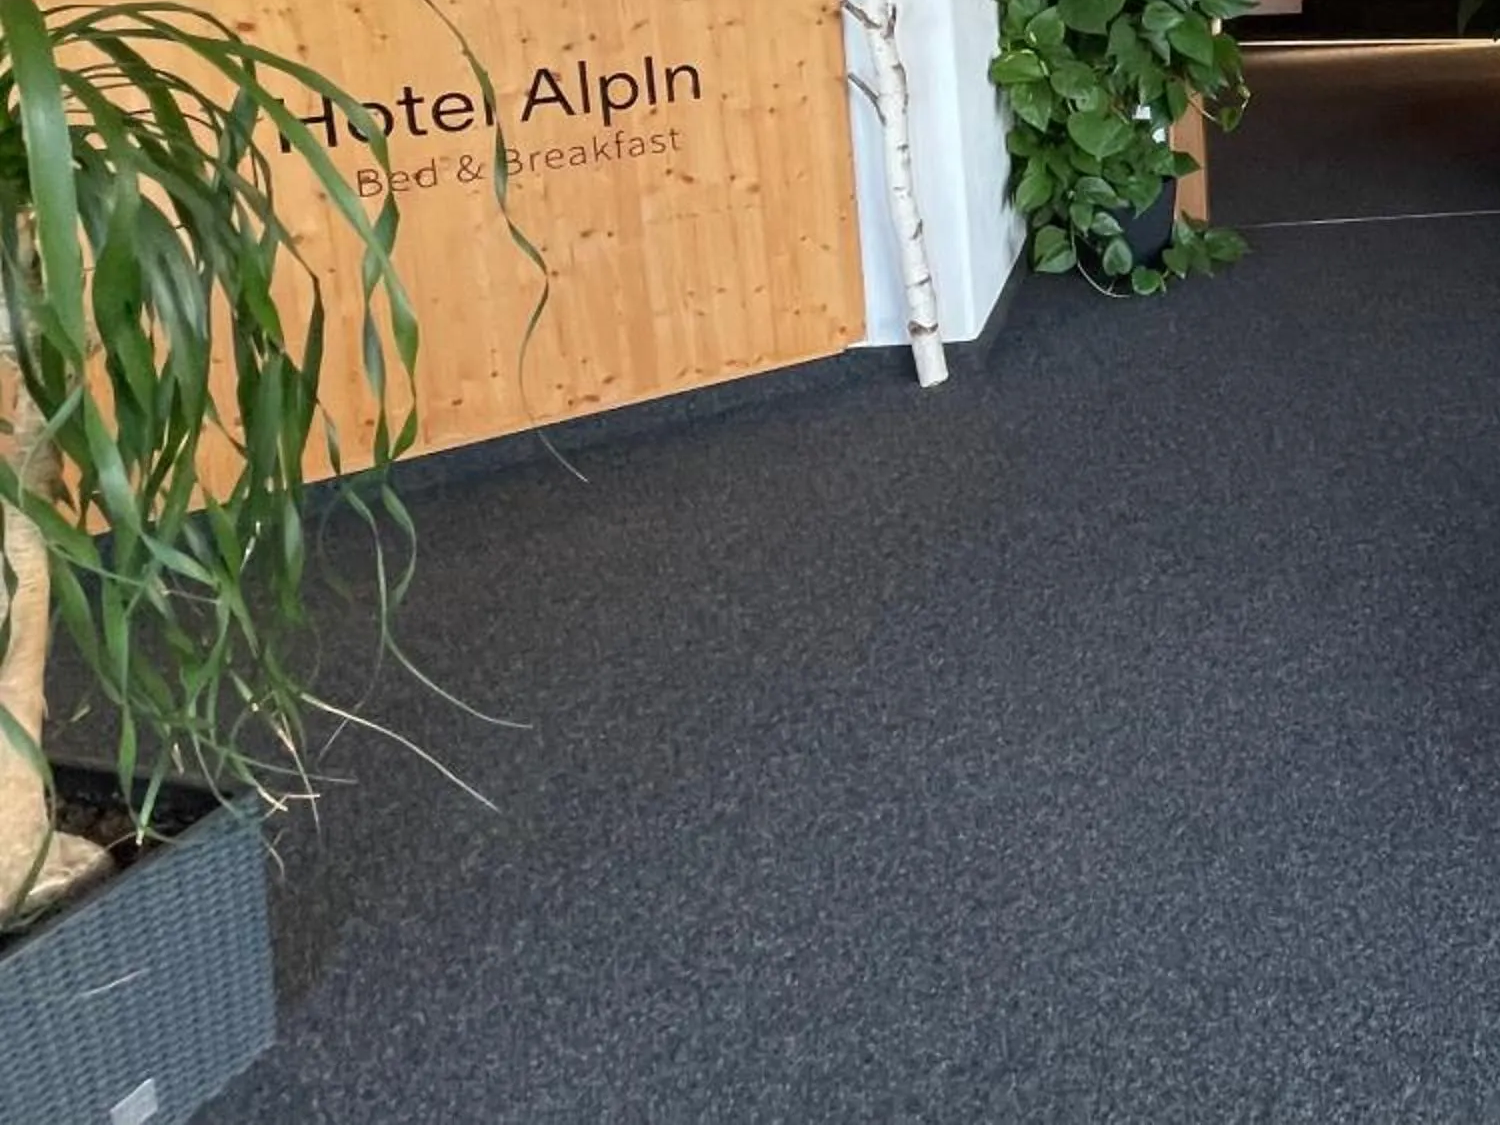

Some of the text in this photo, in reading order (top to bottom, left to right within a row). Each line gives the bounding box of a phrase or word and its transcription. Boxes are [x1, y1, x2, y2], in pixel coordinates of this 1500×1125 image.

[356, 127, 682, 198] Bed & Breakfast
